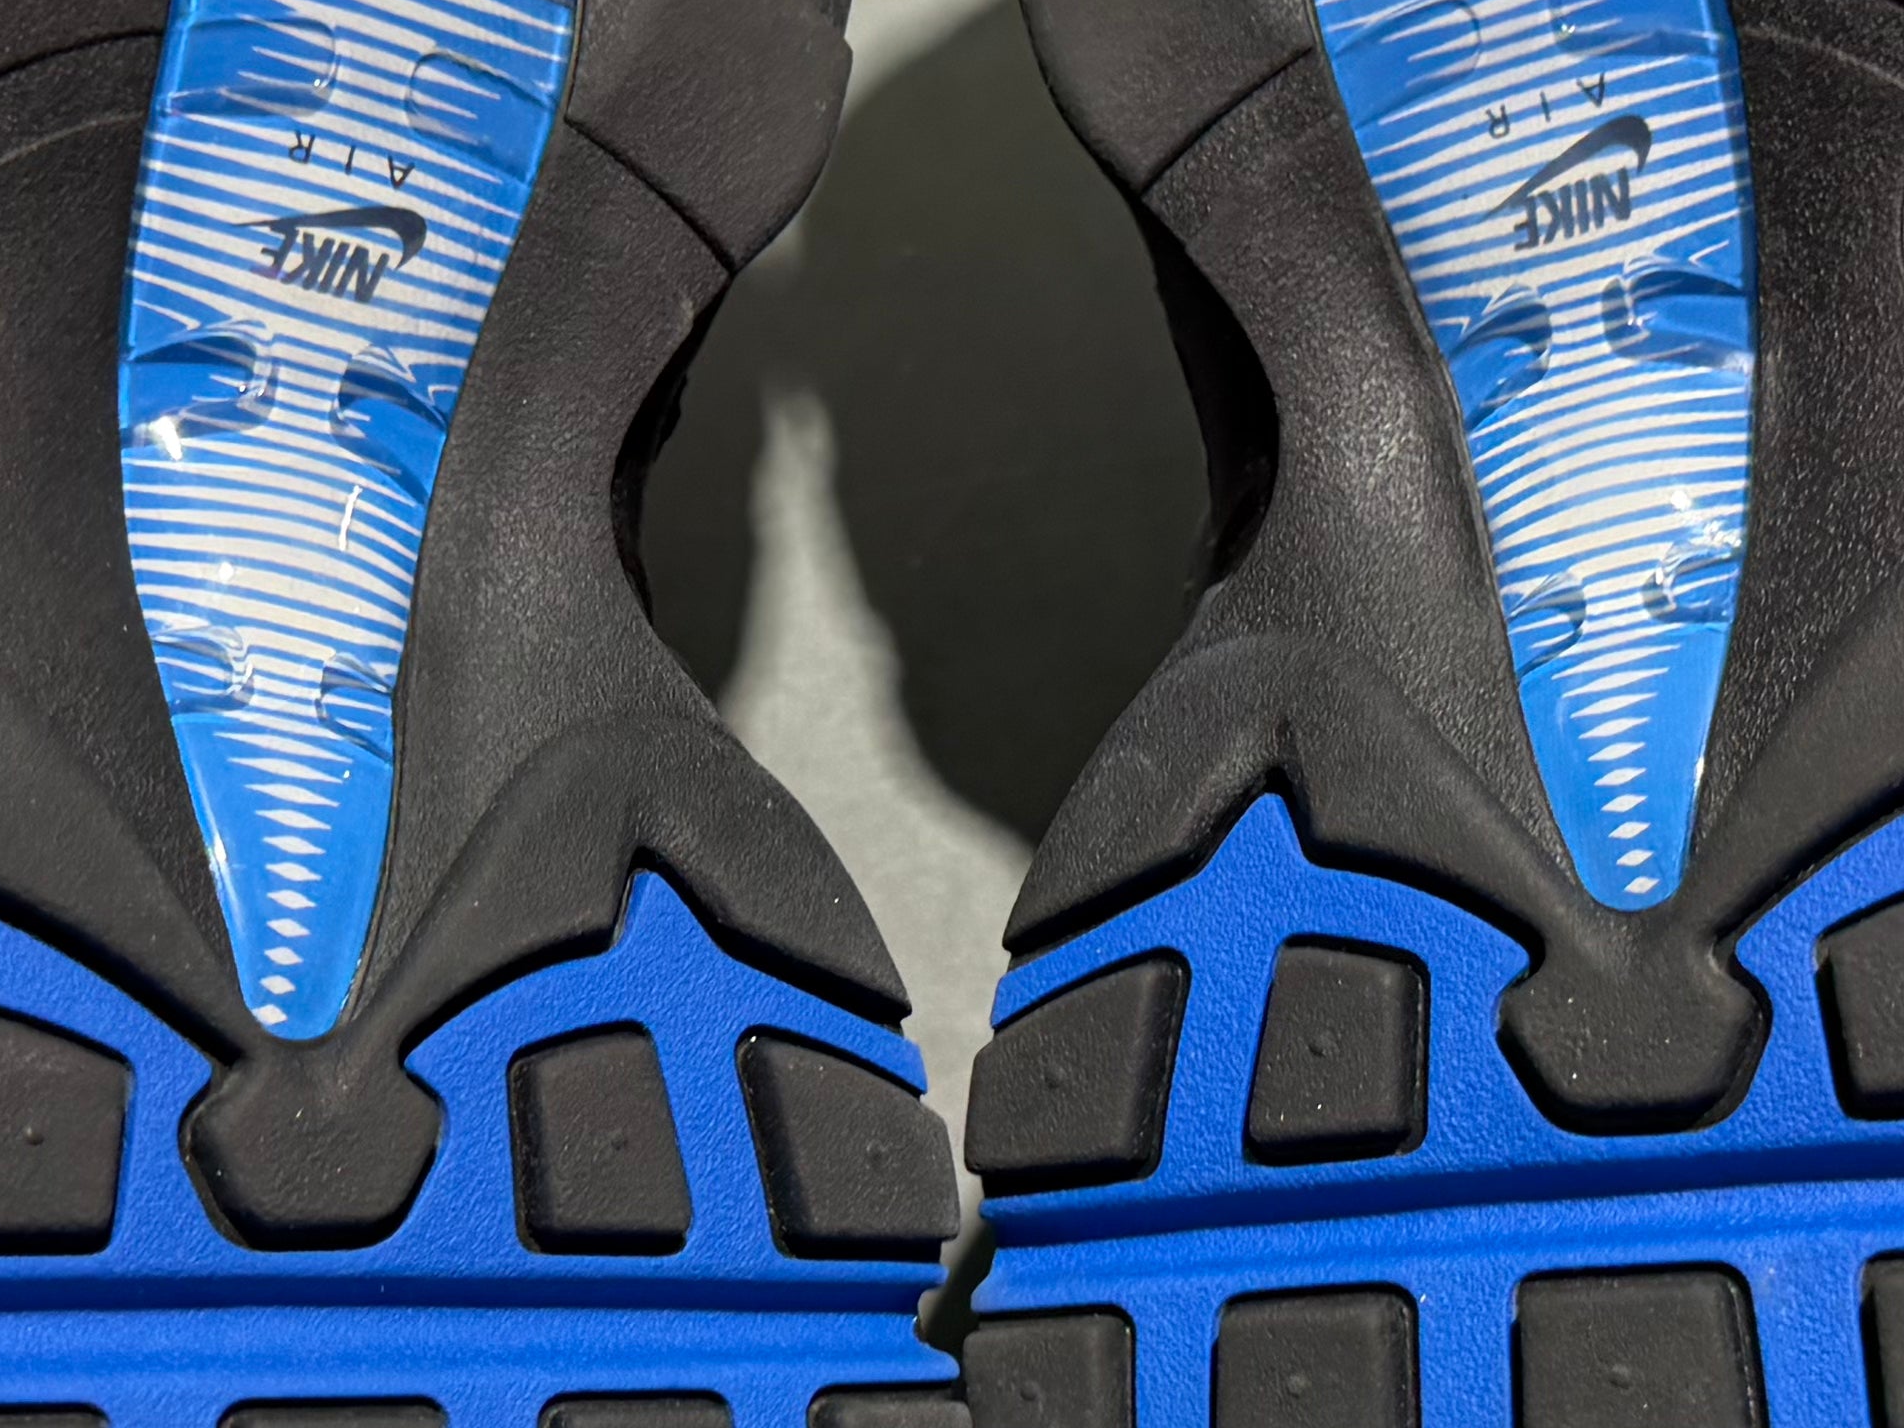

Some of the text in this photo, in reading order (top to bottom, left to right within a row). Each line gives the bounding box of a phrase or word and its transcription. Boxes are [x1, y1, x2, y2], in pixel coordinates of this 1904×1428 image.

[1485, 73, 1606, 139] AIR
[288, 129, 415, 190] AIR
[1514, 167, 1632, 251] NIKE
[252, 224, 391, 303] NIKE
